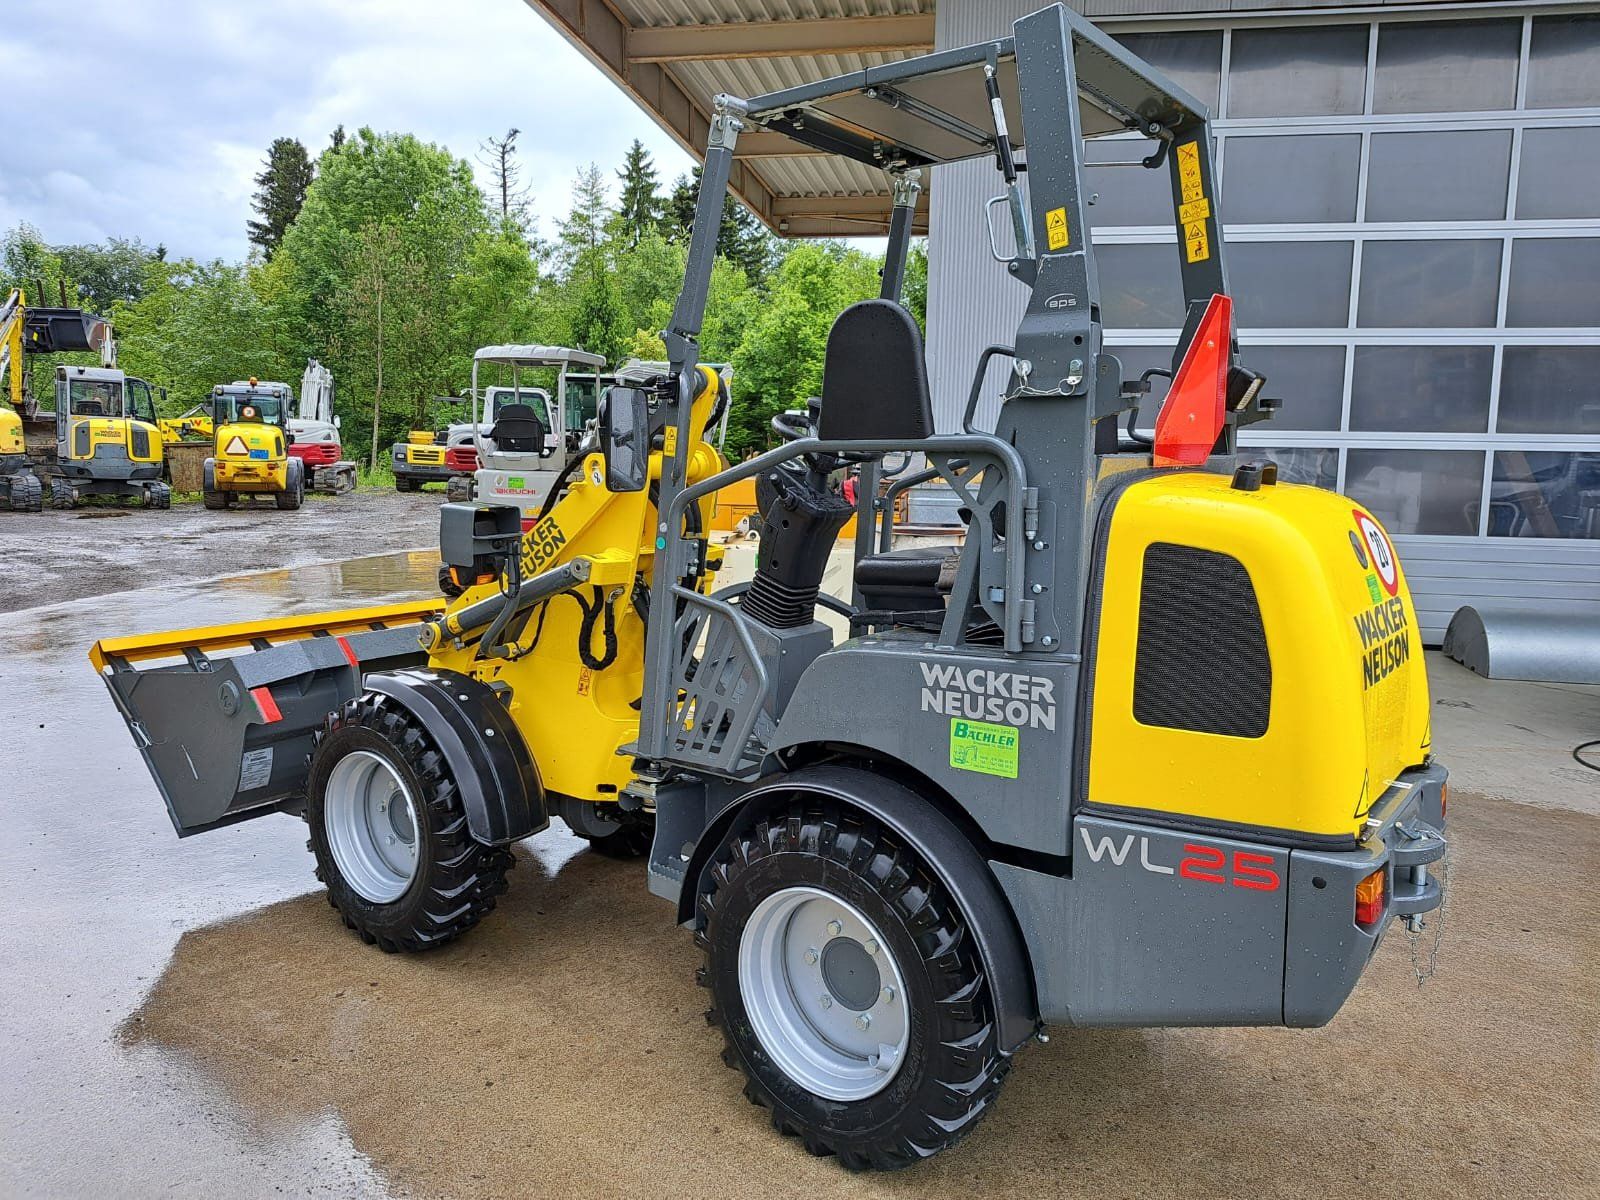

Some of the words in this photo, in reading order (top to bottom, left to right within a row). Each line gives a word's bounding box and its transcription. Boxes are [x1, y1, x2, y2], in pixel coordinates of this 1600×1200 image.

[520, 516, 560, 562] CKER
[1369, 530, 1389, 569] 20
[1353, 596, 1408, 650] WACKER
[1362, 629, 1410, 691] NEUSON
[919, 661, 1057, 705] WACKER
[920, 687, 1057, 732] NEUSON
